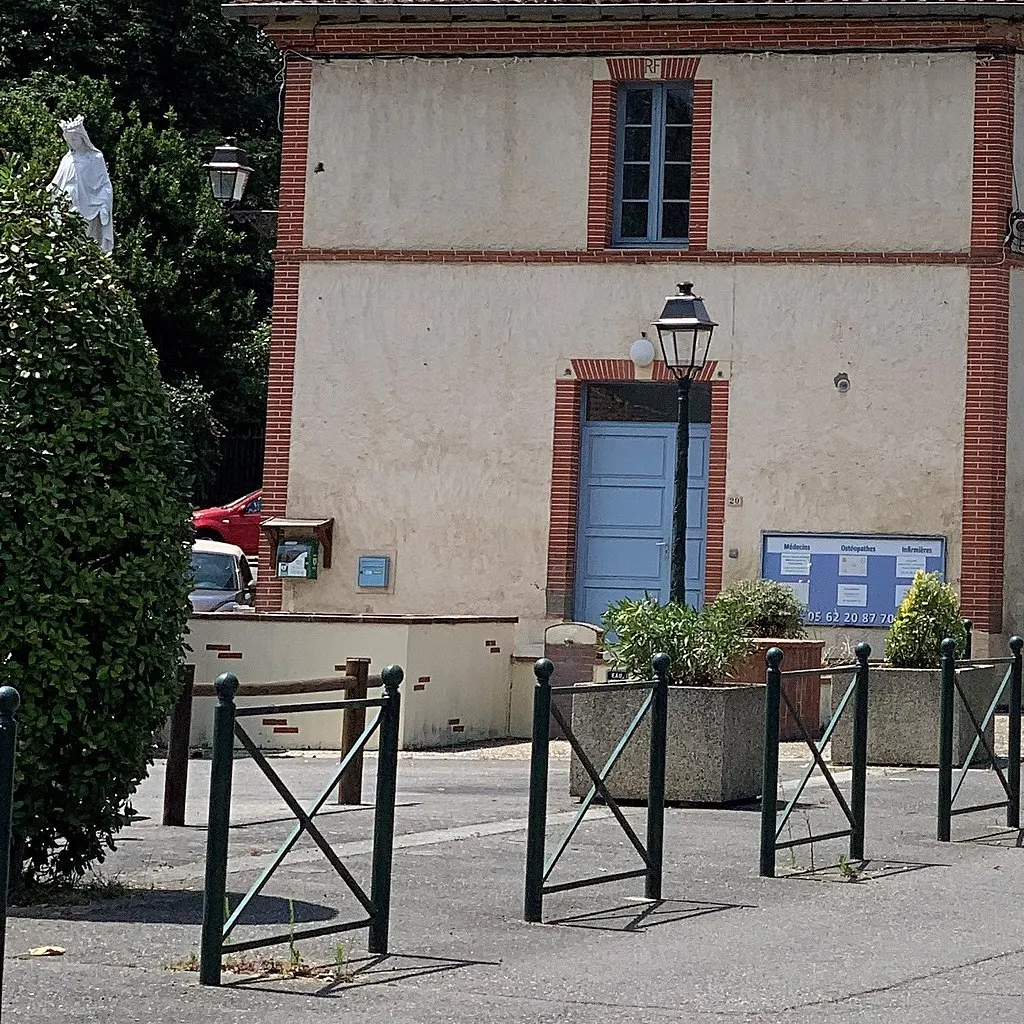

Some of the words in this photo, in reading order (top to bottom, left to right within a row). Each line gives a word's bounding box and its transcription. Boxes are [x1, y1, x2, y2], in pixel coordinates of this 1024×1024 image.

[645, 58, 661, 74] RF
[729, 497, 740, 505] 20
[783, 542, 811, 551] Médecins
[840, 543, 876, 553] Ostéopathes
[901, 546, 933, 554] Infirmières
[808, 611, 821, 622] 05
[825, 612, 839, 623] 62
[844, 612, 858, 623] 20
[862, 613, 876, 623] 87
[881, 613, 894, 624] 70
